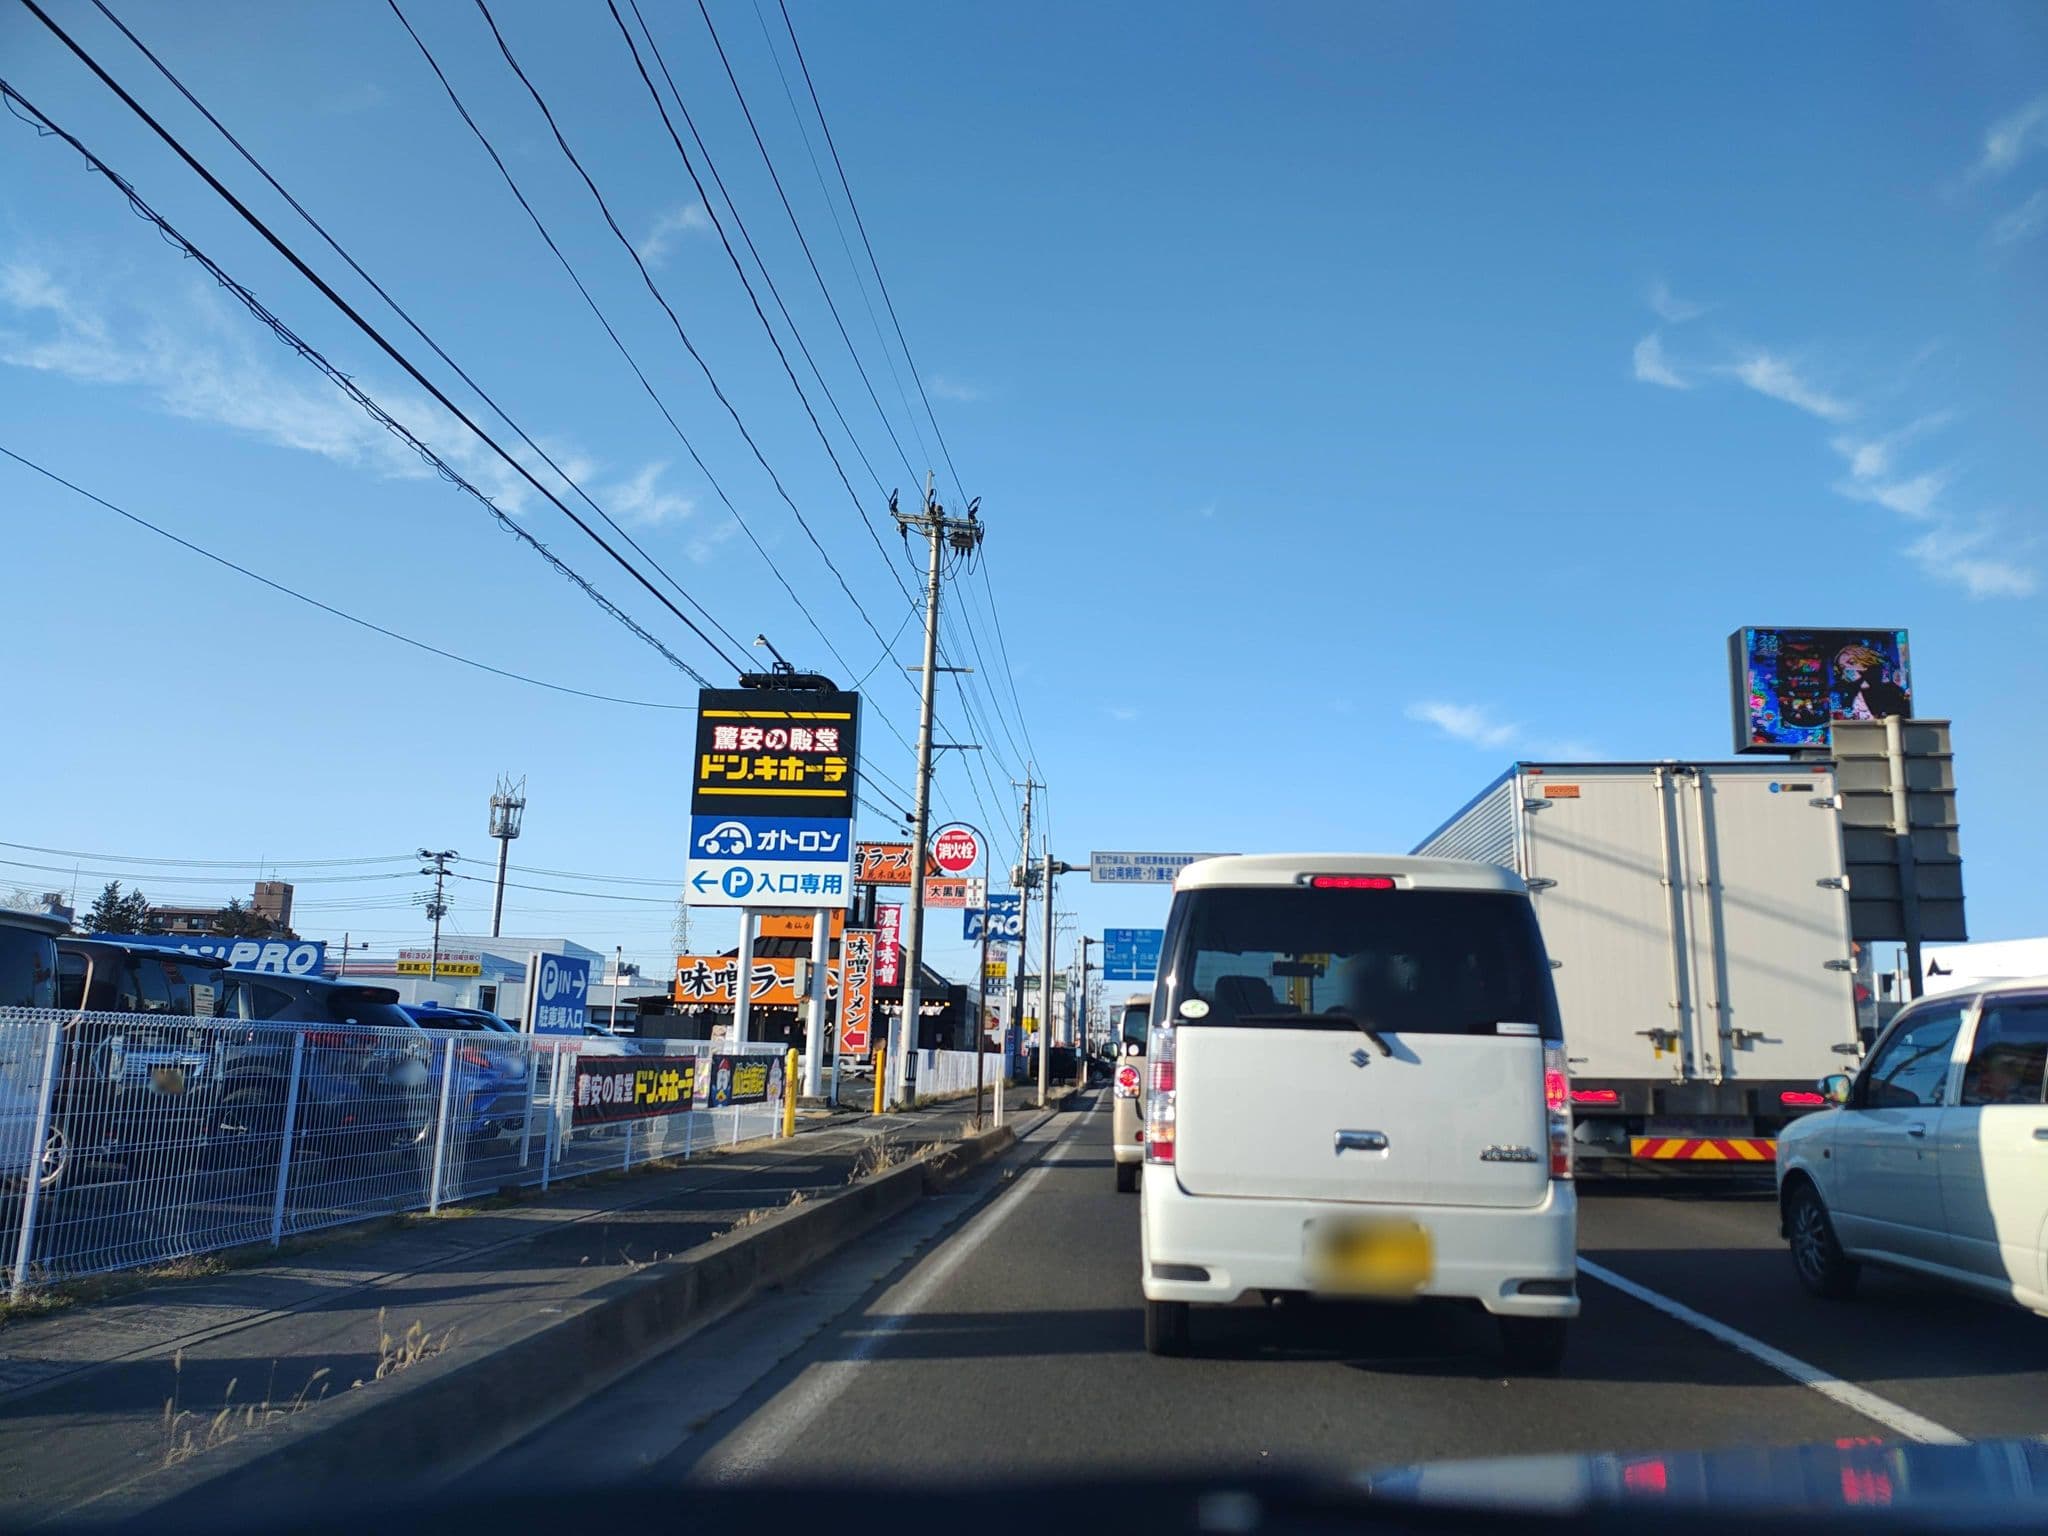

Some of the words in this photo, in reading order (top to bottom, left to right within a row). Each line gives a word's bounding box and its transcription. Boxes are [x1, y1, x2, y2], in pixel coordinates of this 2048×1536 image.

[714, 726, 839, 752] 驚安の殿堂
[757, 829, 841, 852] オトロン
[939, 841, 974, 860] 消火栓
[756, 873, 842, 894] 入口専用
[930, 886, 966, 897] 大黒屋
[228, 942, 318, 975] PRO
[876, 909, 899, 985] 濃厚味噌
[558, 971, 572, 994] IN
[846, 937, 872, 1028] 味噌ラーメン
[537, 1005, 584, 1029] 駐車場入口
[578, 1073, 634, 1106] 驚安の殿堂
